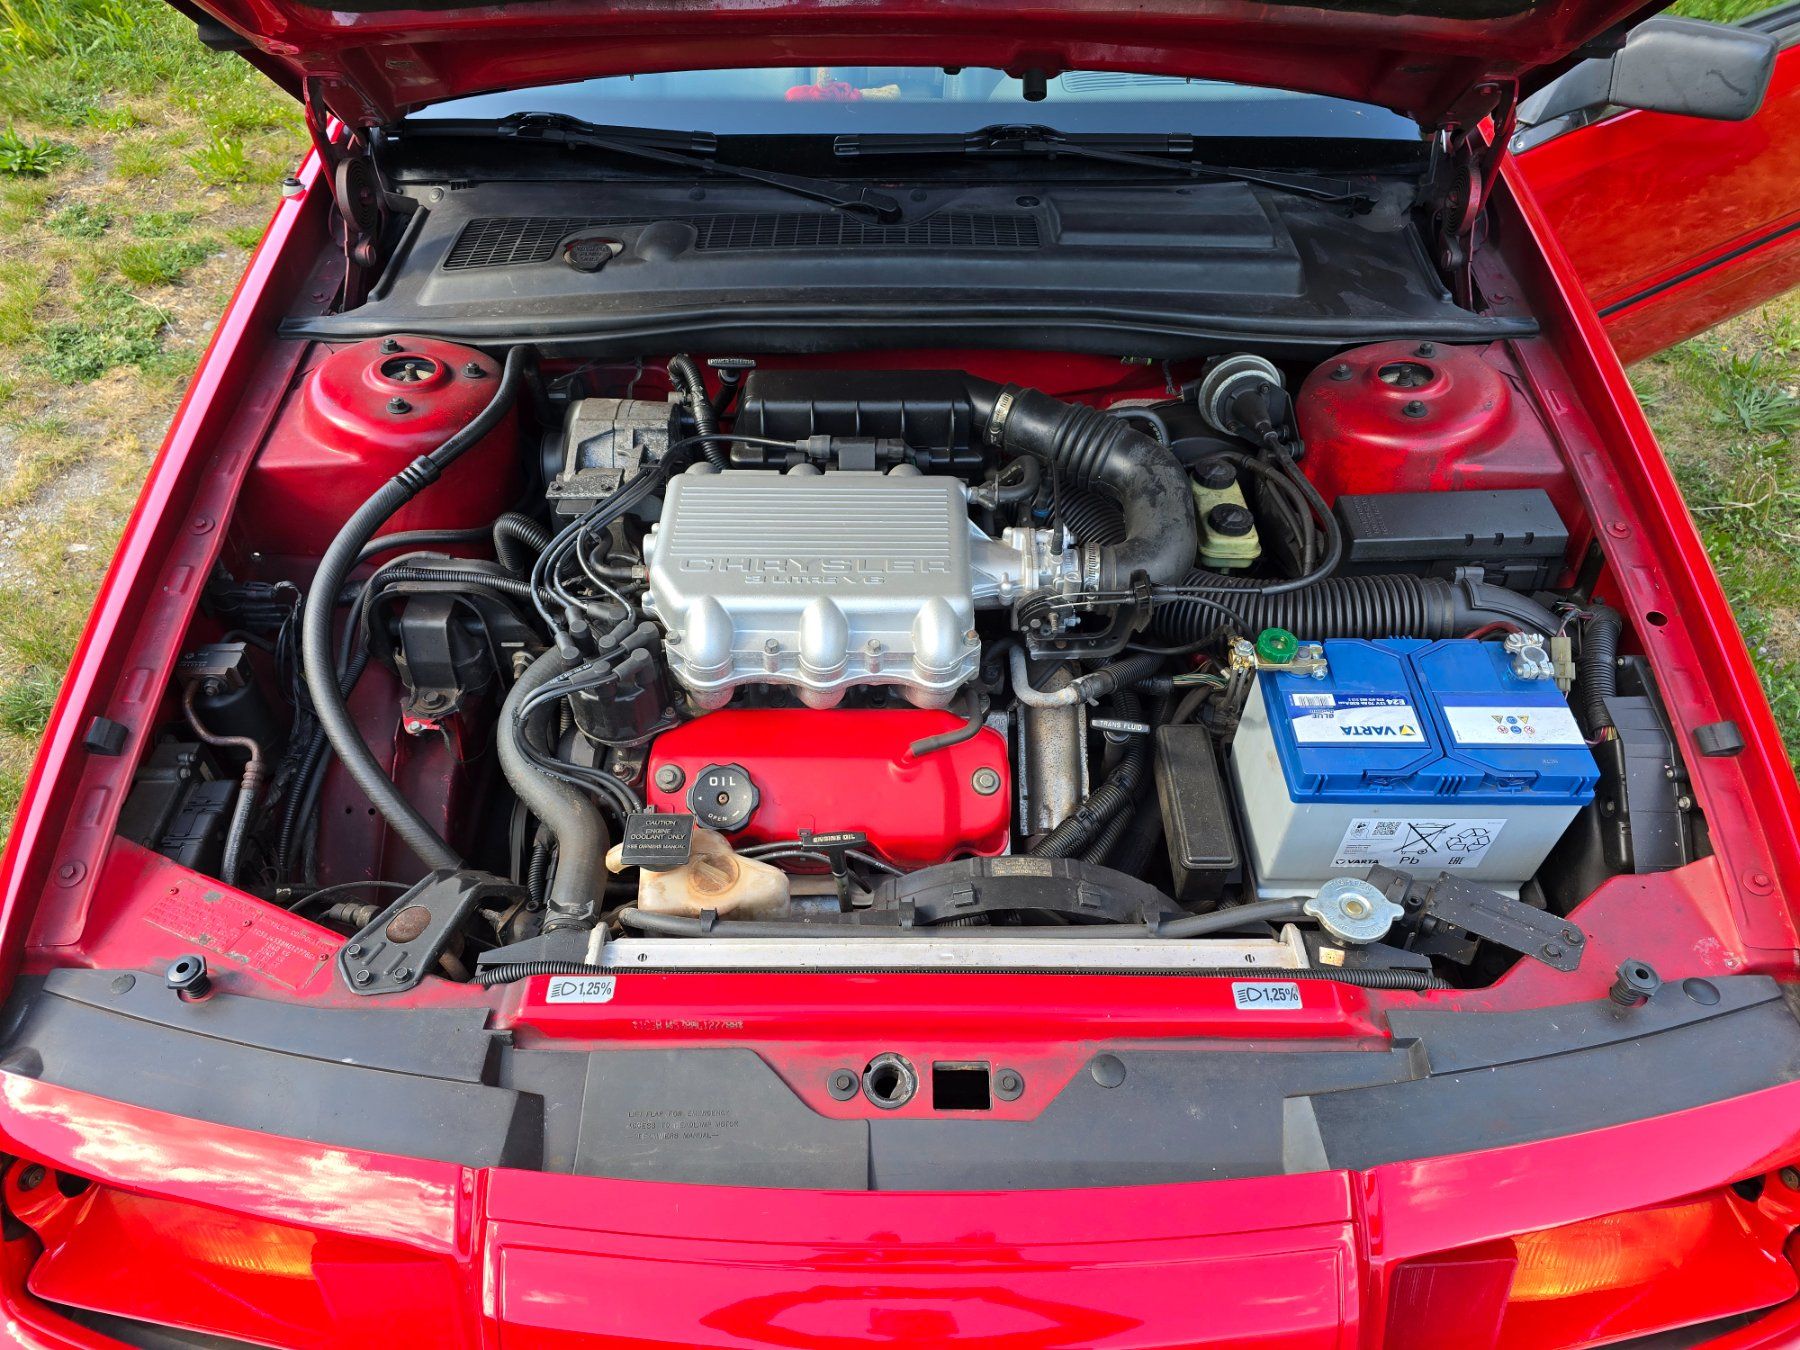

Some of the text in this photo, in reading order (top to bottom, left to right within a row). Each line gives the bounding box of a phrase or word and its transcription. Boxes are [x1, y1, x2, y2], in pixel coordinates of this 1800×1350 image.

[679, 557, 951, 573] CHRYSLER
[744, 575, 766, 585] 3
[1386, 698, 1406, 706] E24
[1100, 720, 1143, 731] TRANS FLUID
[1340, 725, 1397, 736] VARTA
[709, 776, 736, 786] OIL
[707, 812, 728, 822] OPEN
[813, 835, 842, 843] ENGINE
[1399, 856, 1420, 865] Pb
[578, 981, 613, 996] 1,25%
[1262, 986, 1299, 1003] 1,25%
[628, 1121, 656, 1130] ACCESS
[661, 1121, 671, 1129] TO
[716, 1120, 739, 1128] MOTOR
